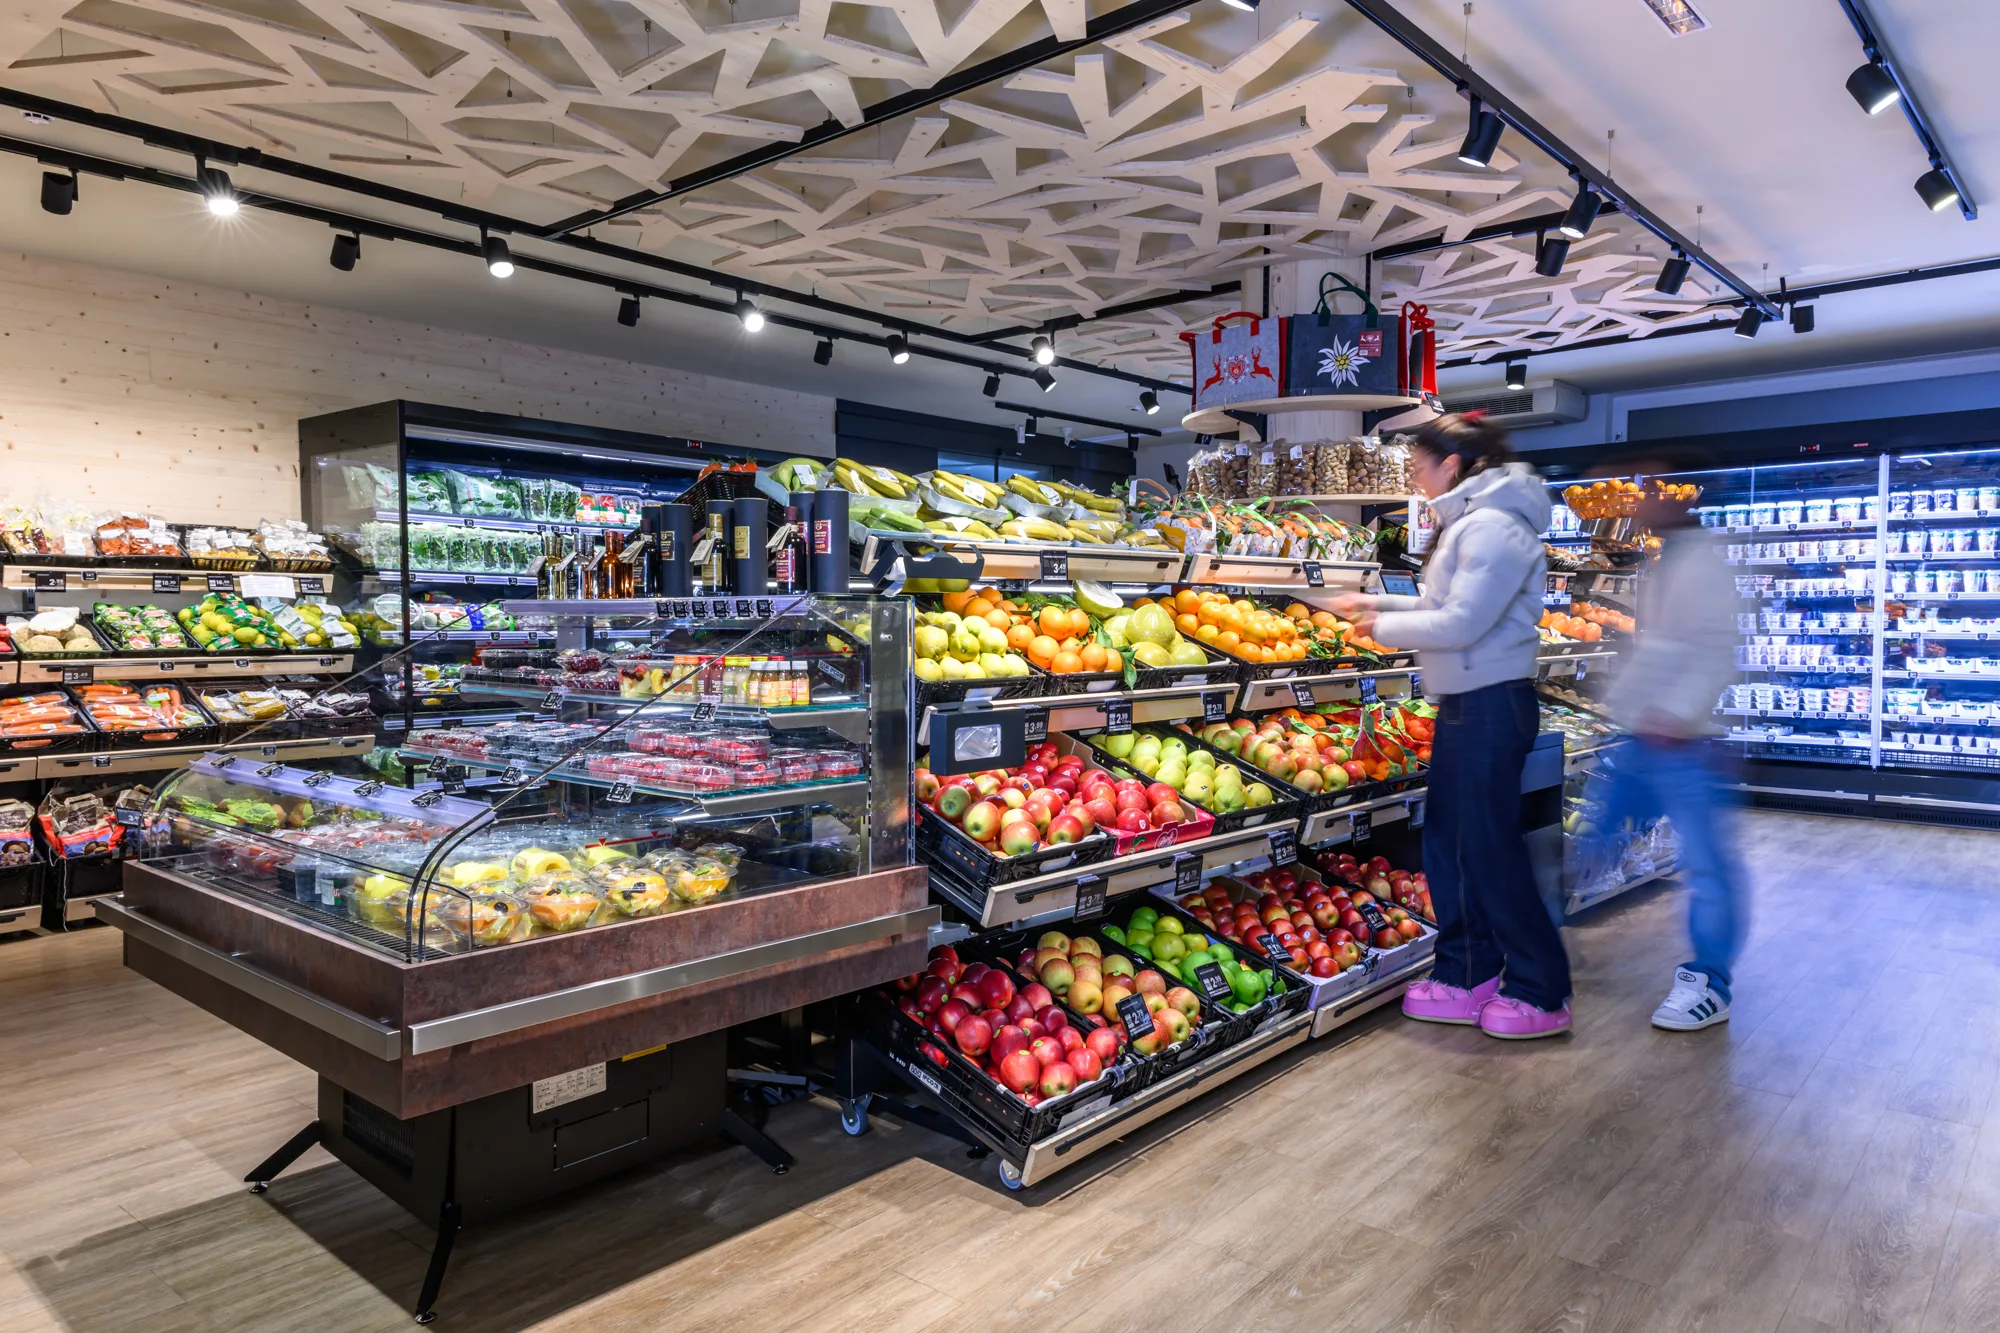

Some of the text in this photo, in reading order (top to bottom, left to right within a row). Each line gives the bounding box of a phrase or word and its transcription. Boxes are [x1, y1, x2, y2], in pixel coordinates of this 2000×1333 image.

[1053, 563, 1066, 573] 3.49
[49, 578, 64, 586] 2.99
[1116, 712, 1128, 724] 2.99
[1030, 721, 1043, 733] 3.99
[1281, 845, 1293, 857] 3.29
[1184, 869, 1197, 882] 4.79
[1210, 975, 1222, 988] 2.99
[1132, 1009, 1144, 1024] 2.79
